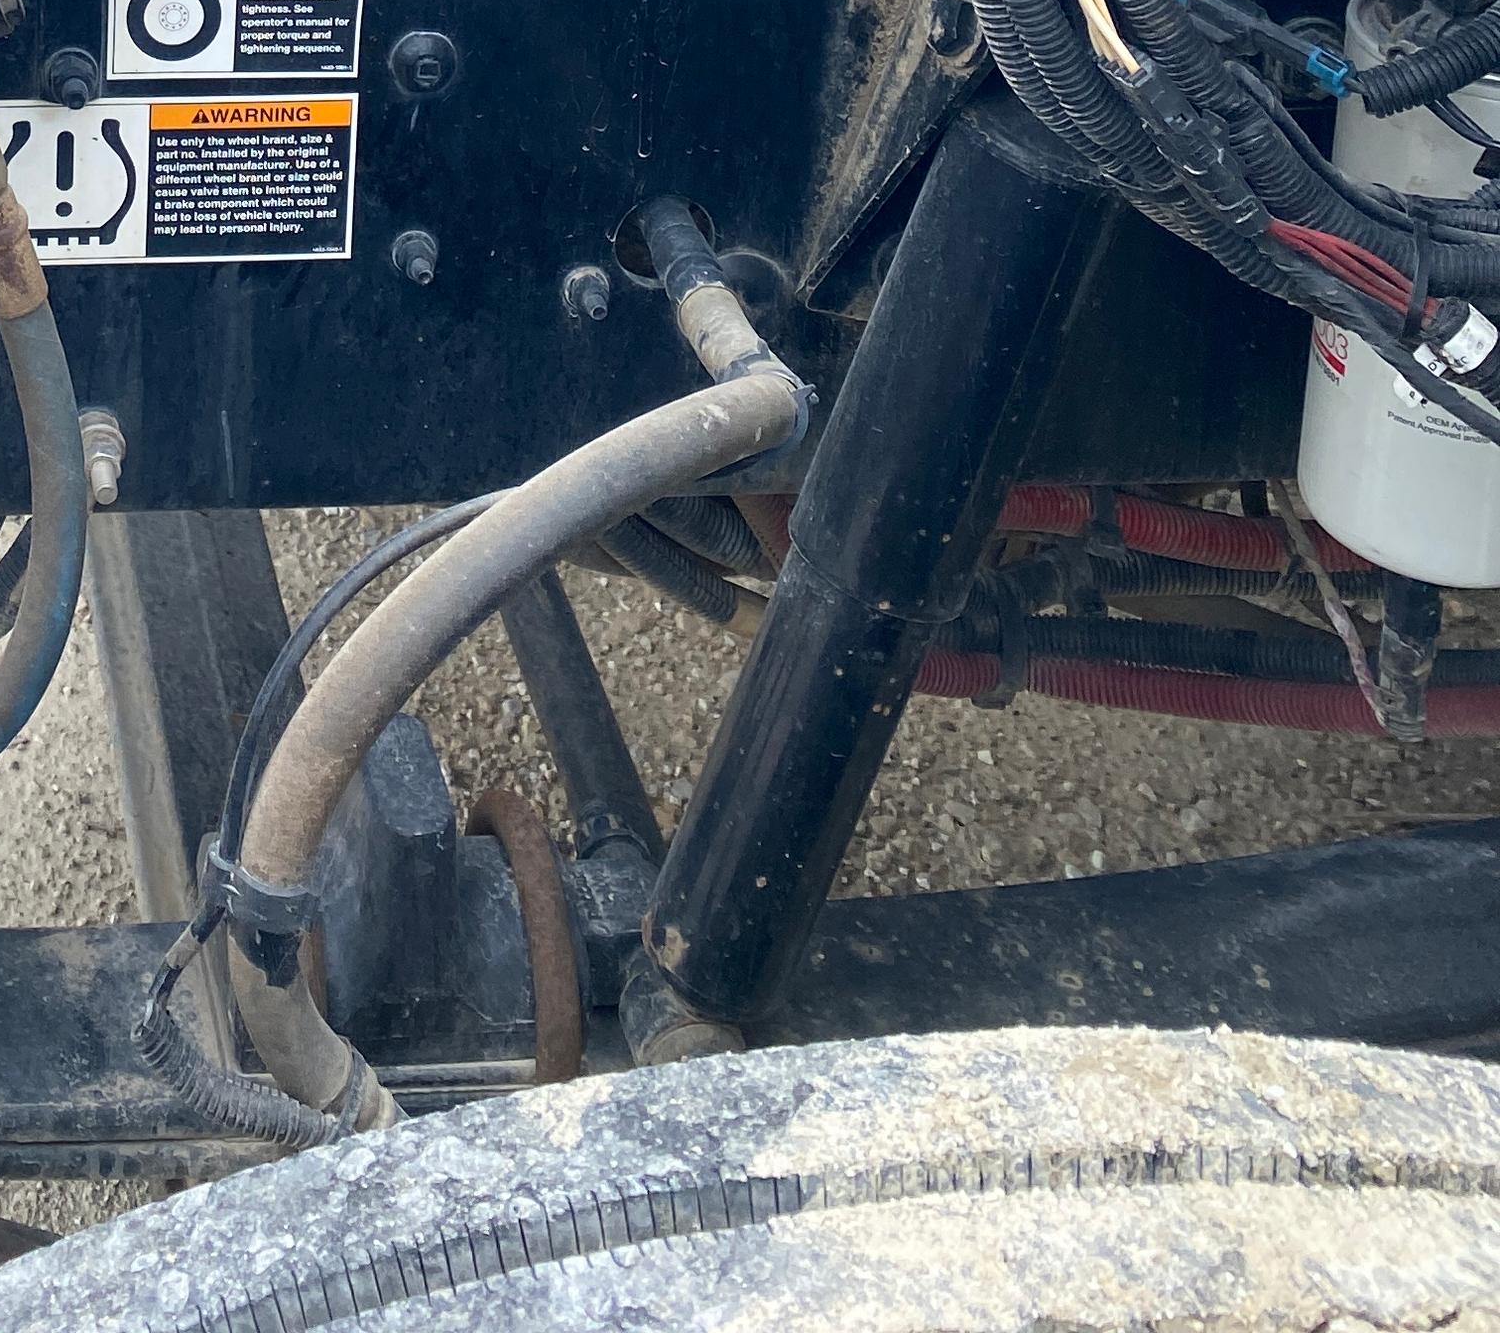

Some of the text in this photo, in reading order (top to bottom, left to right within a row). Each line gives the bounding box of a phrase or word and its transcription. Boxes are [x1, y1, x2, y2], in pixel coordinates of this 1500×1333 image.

[242, 4, 314, 15] tightness. See
[241, 17, 350, 28] operator's manual for
[240, 31, 332, 41] proper torque and
[240, 44, 344, 55] tightening sequence.
[210, 107, 311, 123] WARNING
[156, 133, 333, 148] Use only the wheel brand, size &
[156, 147, 329, 161] part no. installed by the original
[155, 158, 340, 173] equipment manufacturer. Use of a
[155, 171, 343, 184] different wheel brand or size could
[155, 183, 337, 197] cause valve stem to interfere with
[154, 196, 328, 210] a brake component which could
[154, 208, 337, 222] lead to loss of vehicle control and
[154, 222, 304, 236] may lead to personal injury.
[1417, 422, 1461, 441] Approved
